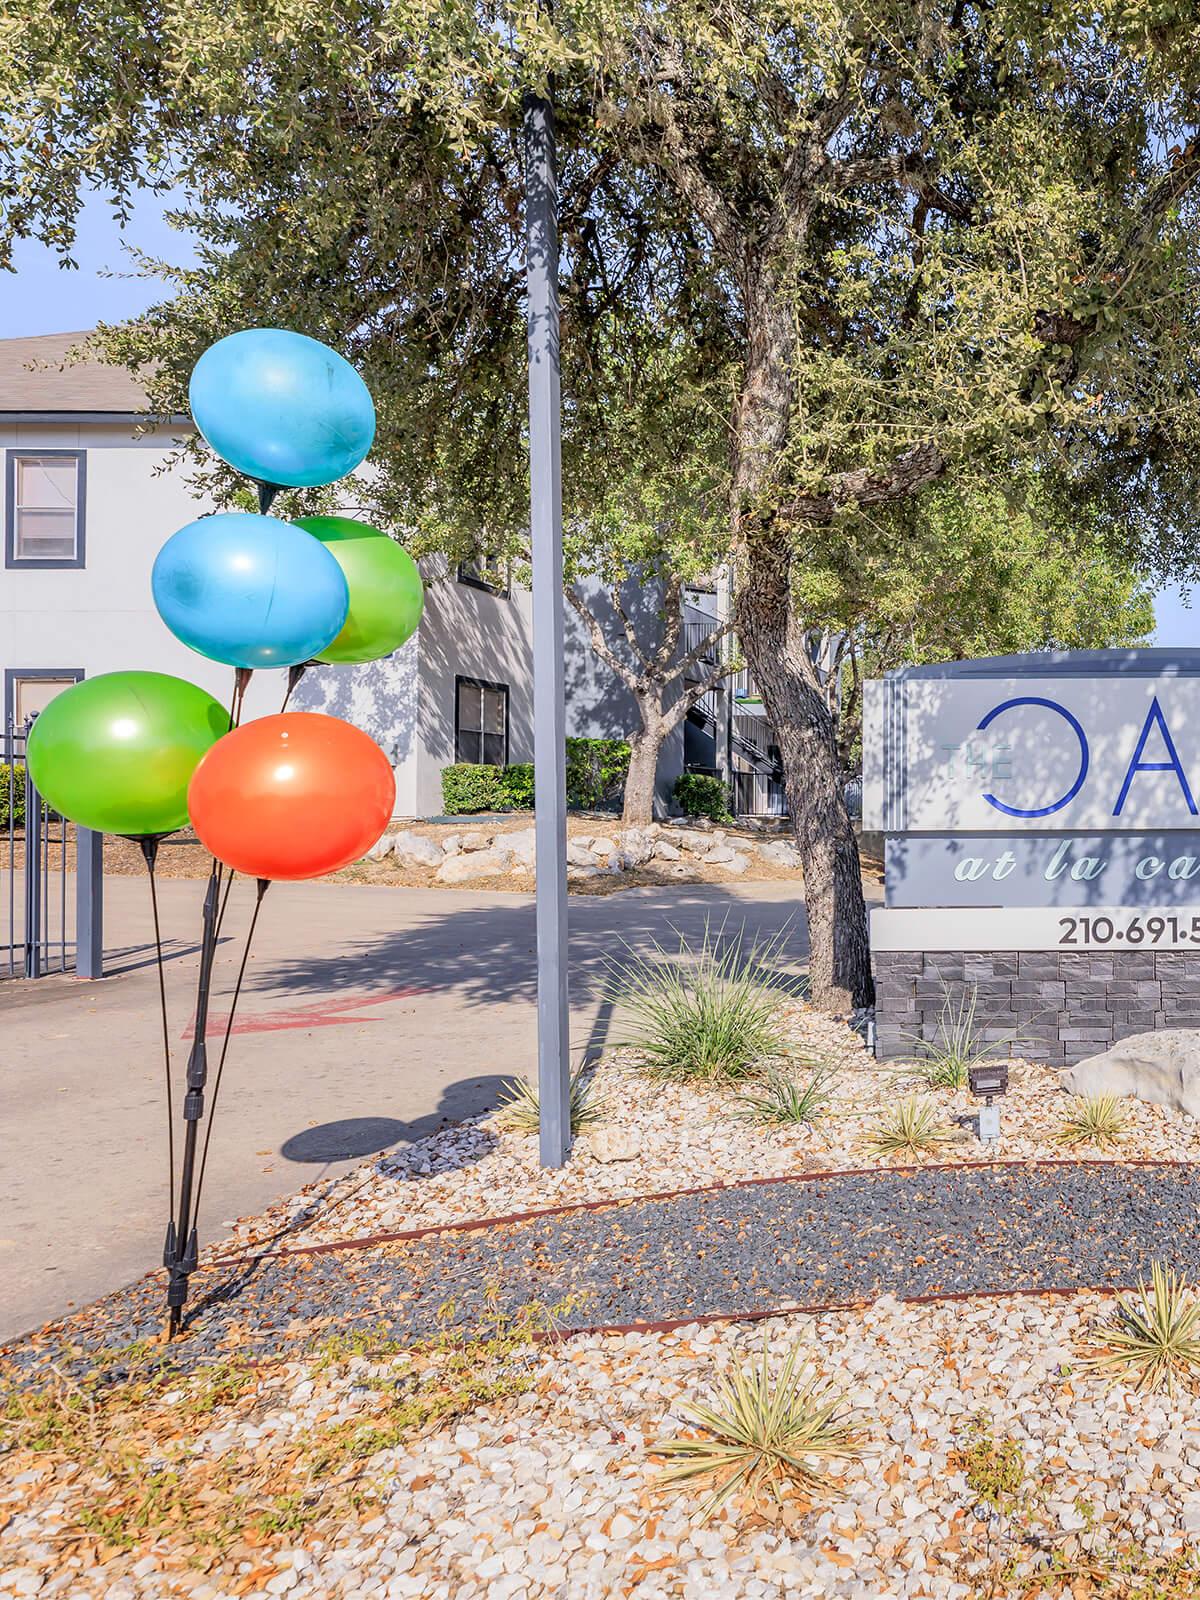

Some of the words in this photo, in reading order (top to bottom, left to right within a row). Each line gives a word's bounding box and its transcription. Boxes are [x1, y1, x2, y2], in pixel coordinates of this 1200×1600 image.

[941, 744, 1012, 779] THE
[953, 850, 1017, 882] at
[1043, 839, 1107, 882] la
